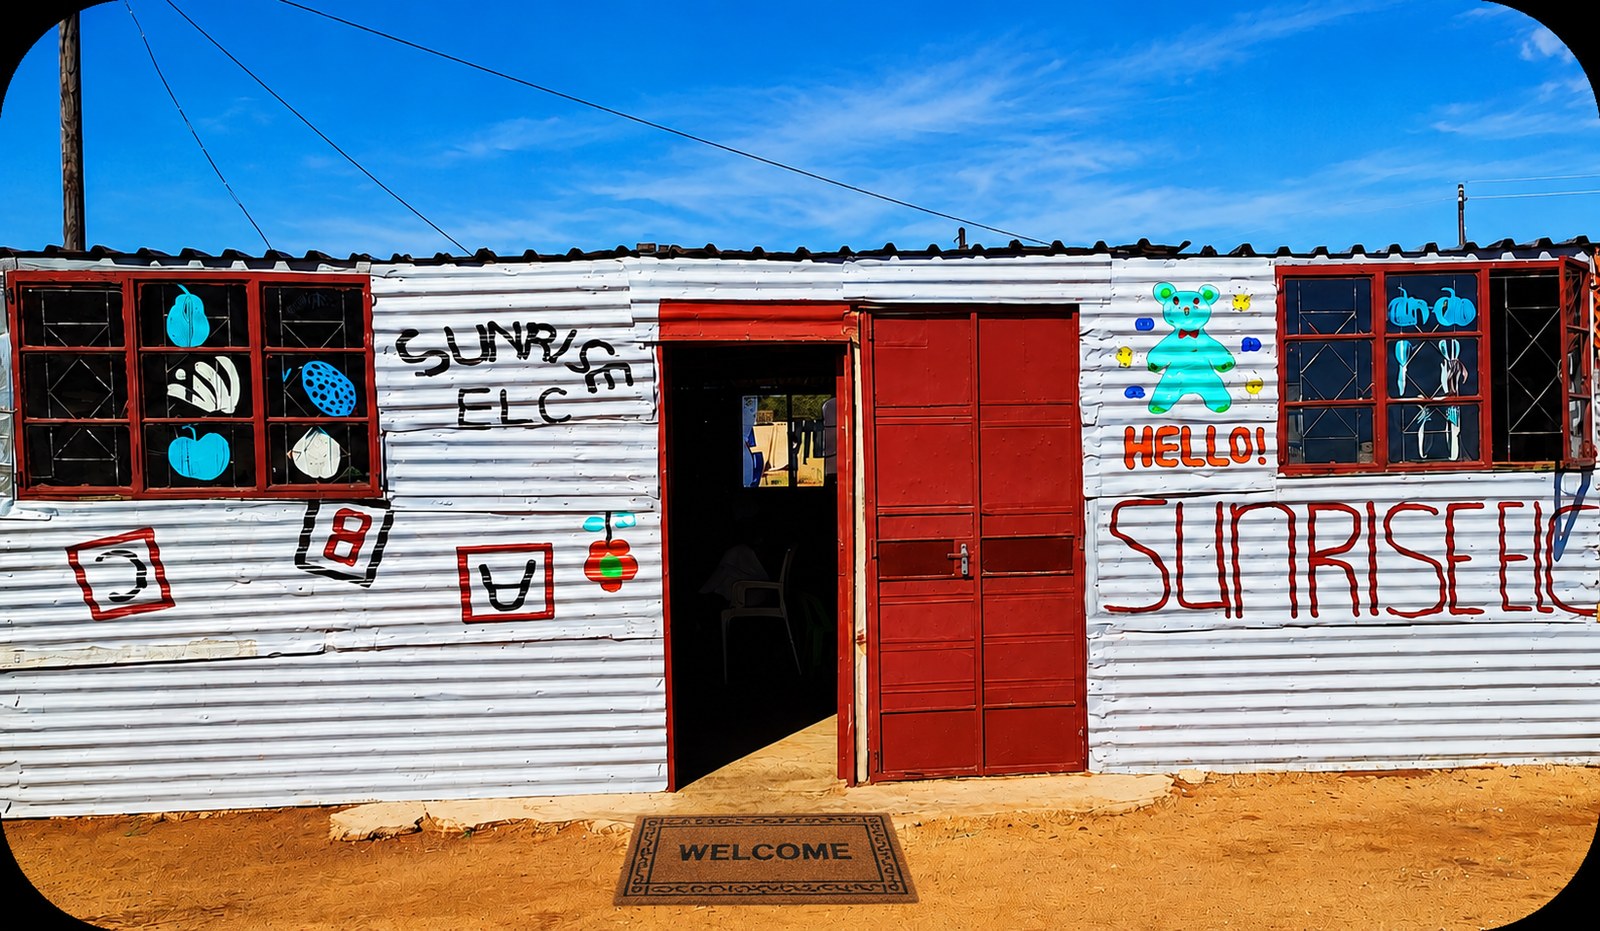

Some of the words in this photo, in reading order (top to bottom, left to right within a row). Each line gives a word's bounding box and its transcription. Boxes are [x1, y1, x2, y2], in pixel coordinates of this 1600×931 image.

[395, 321, 634, 393] SUNRISE
[458, 387, 572, 427] ELC
[1123, 425, 1266, 470] HELLO!
[679, 842, 852, 861] WELCOME
